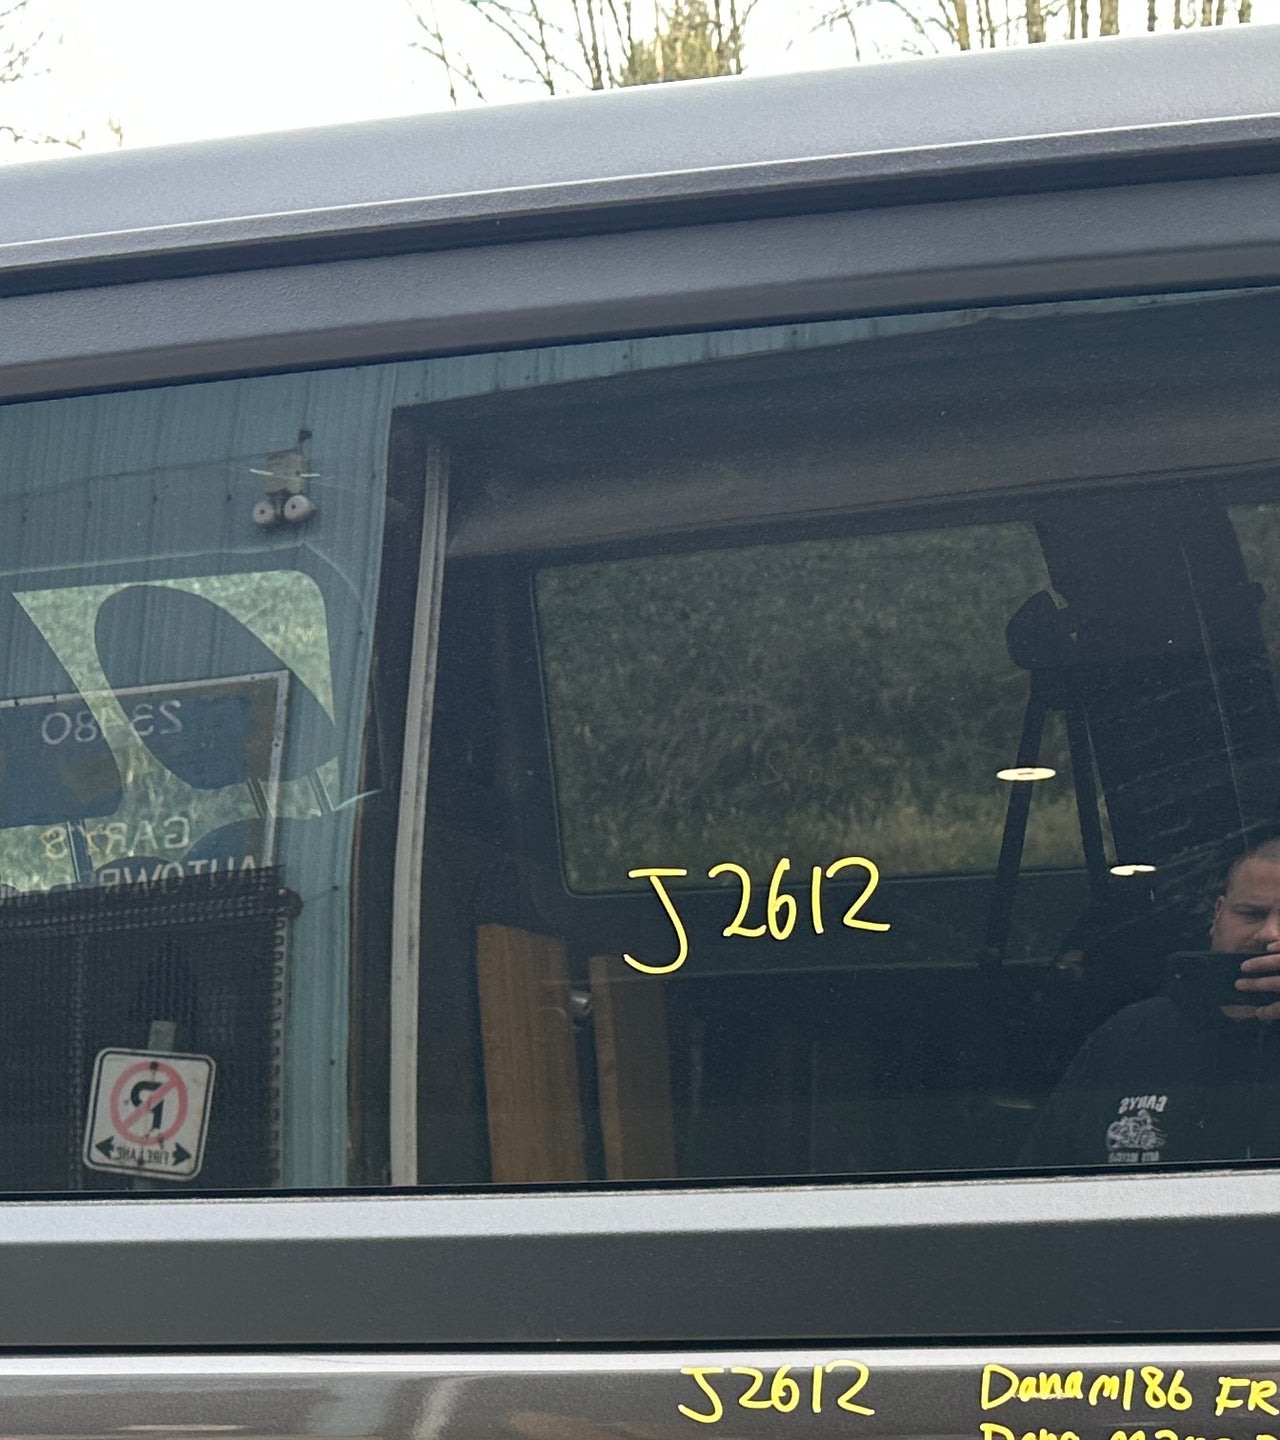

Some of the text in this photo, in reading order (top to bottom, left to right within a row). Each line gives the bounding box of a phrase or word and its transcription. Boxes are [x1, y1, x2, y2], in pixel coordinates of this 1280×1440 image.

[623, 857, 891, 974] J2612
[677, 1359, 875, 1423] J2612
[980, 1364, 1084, 1411] Dana
[1215, 1375, 1280, 1416] FR
